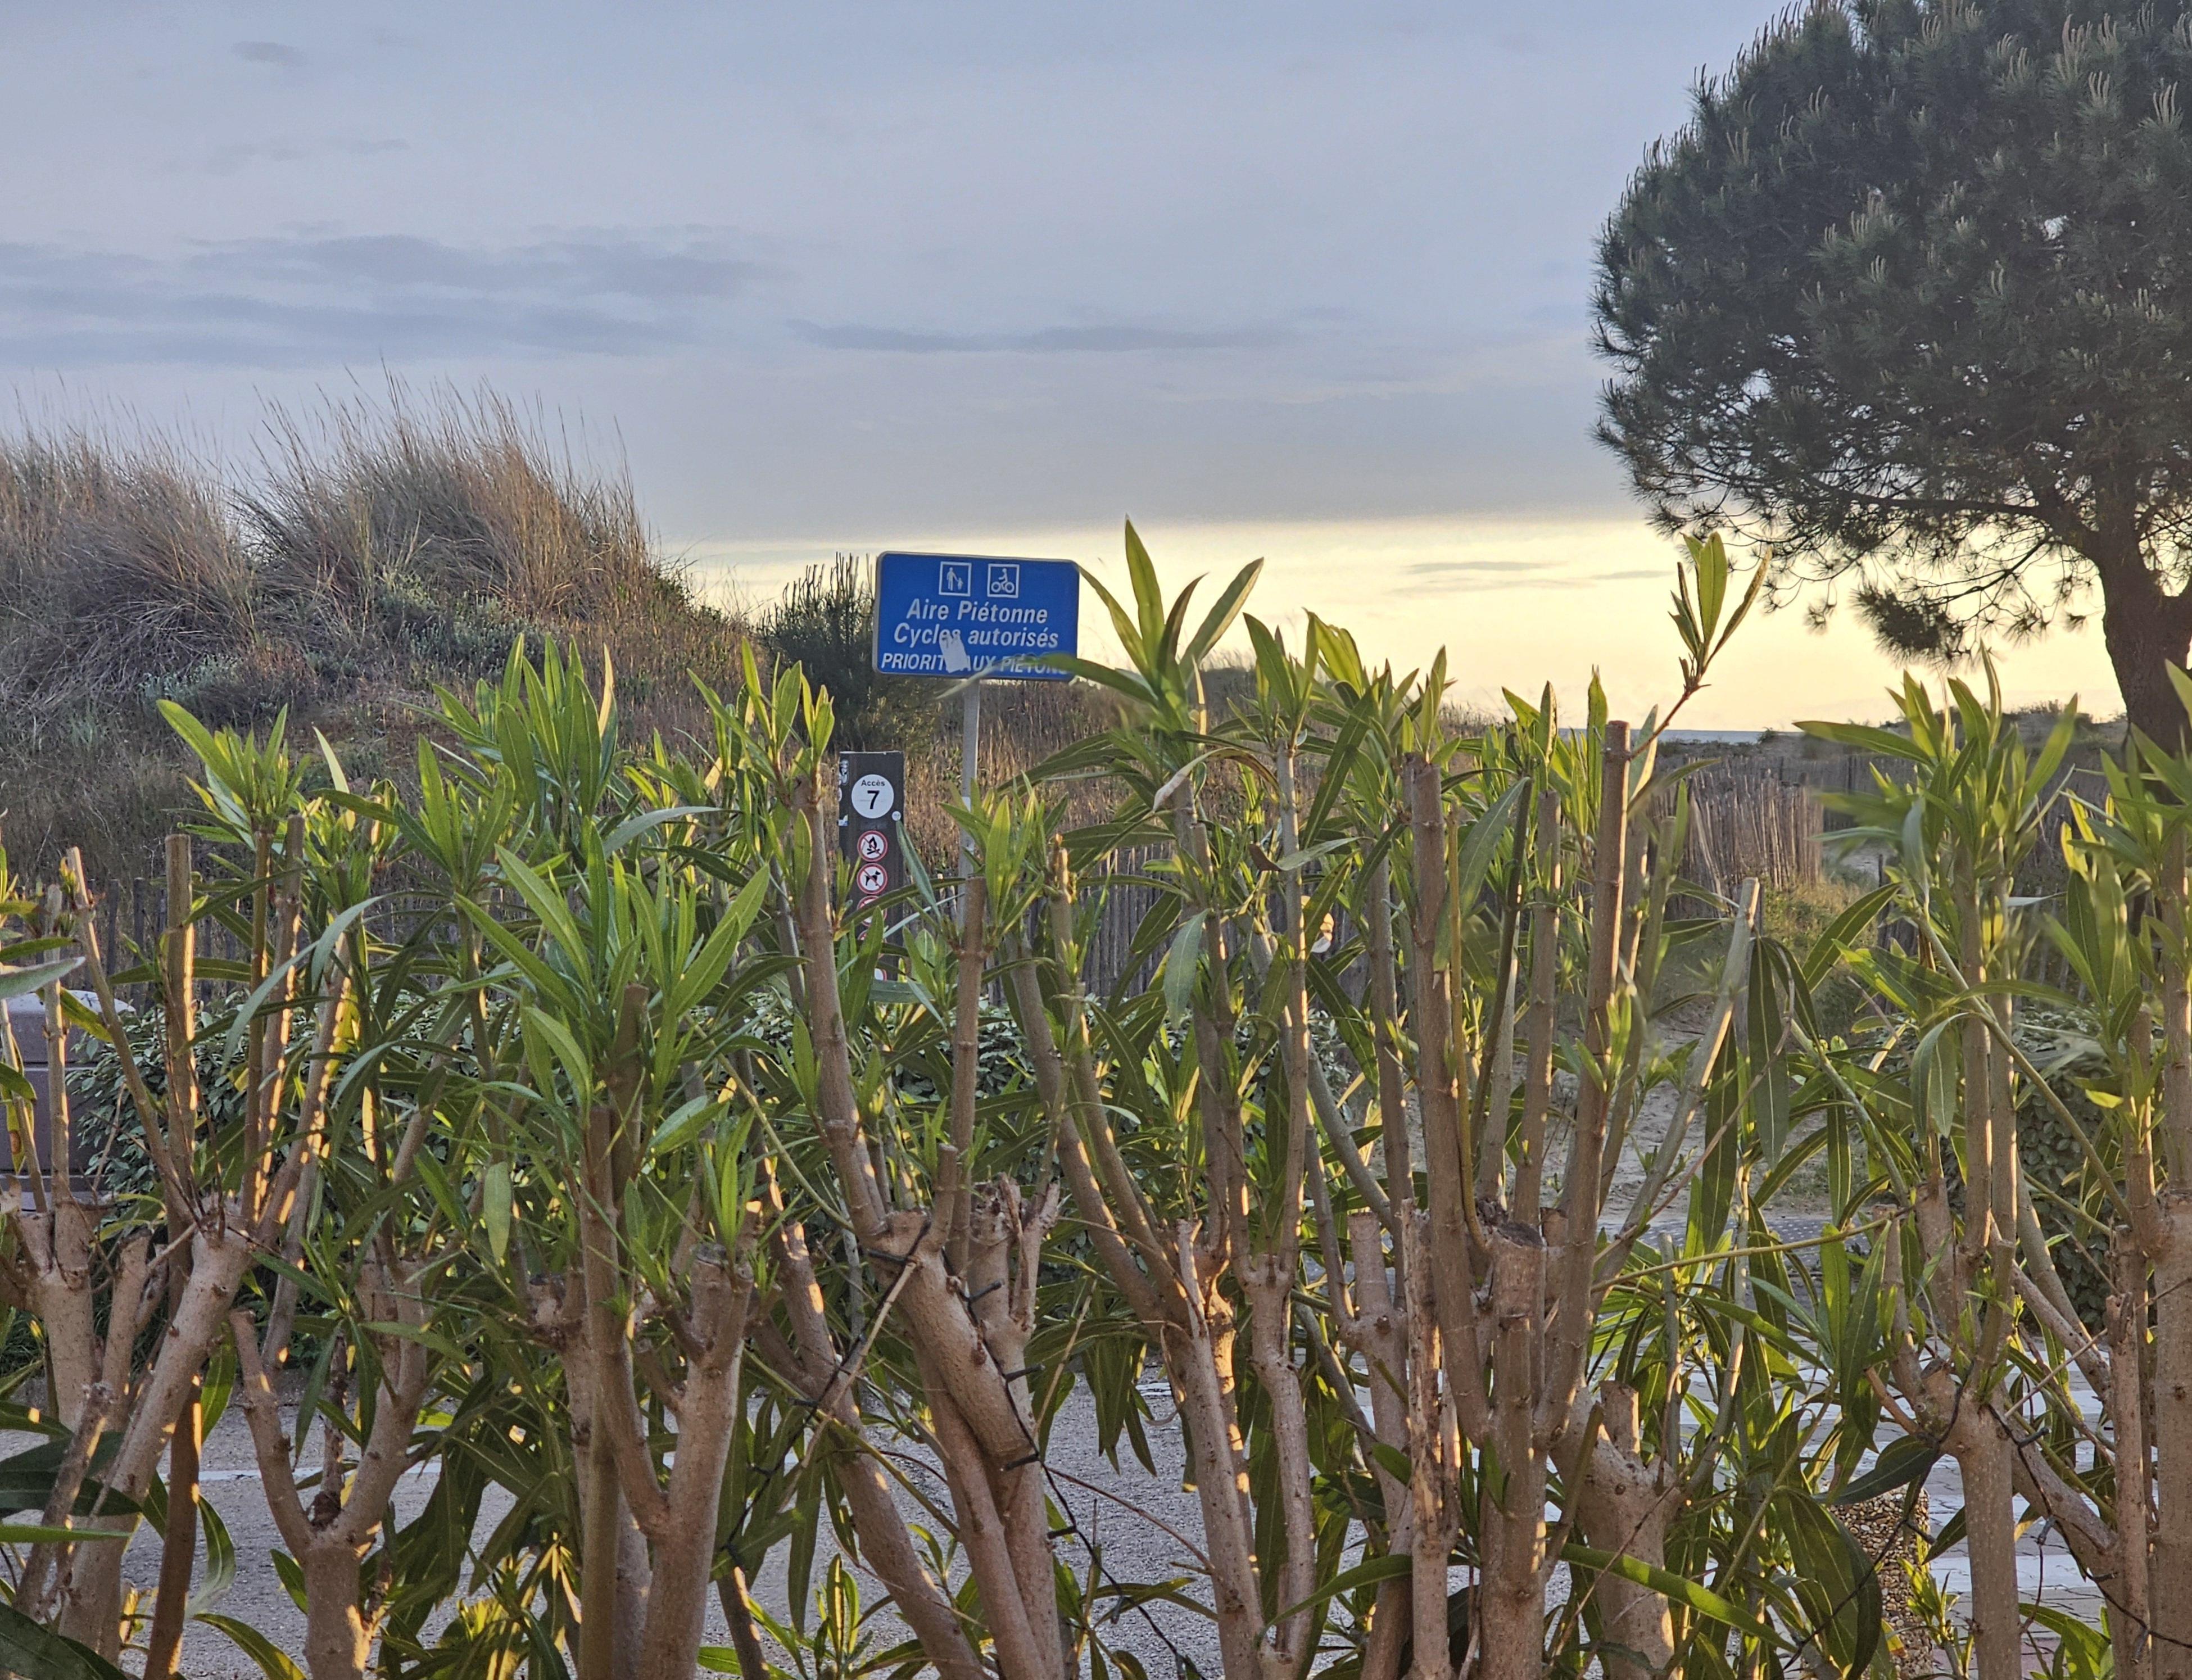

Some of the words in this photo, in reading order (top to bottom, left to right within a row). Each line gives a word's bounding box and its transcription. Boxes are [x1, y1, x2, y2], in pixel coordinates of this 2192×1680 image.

[906, 598, 949, 620] Aire
[957, 600, 1048, 623] Piétonne
[967, 627, 1059, 648] autorisés
[881, 652, 959, 672] PRIORIT
[867, 790, 880, 810] 7
